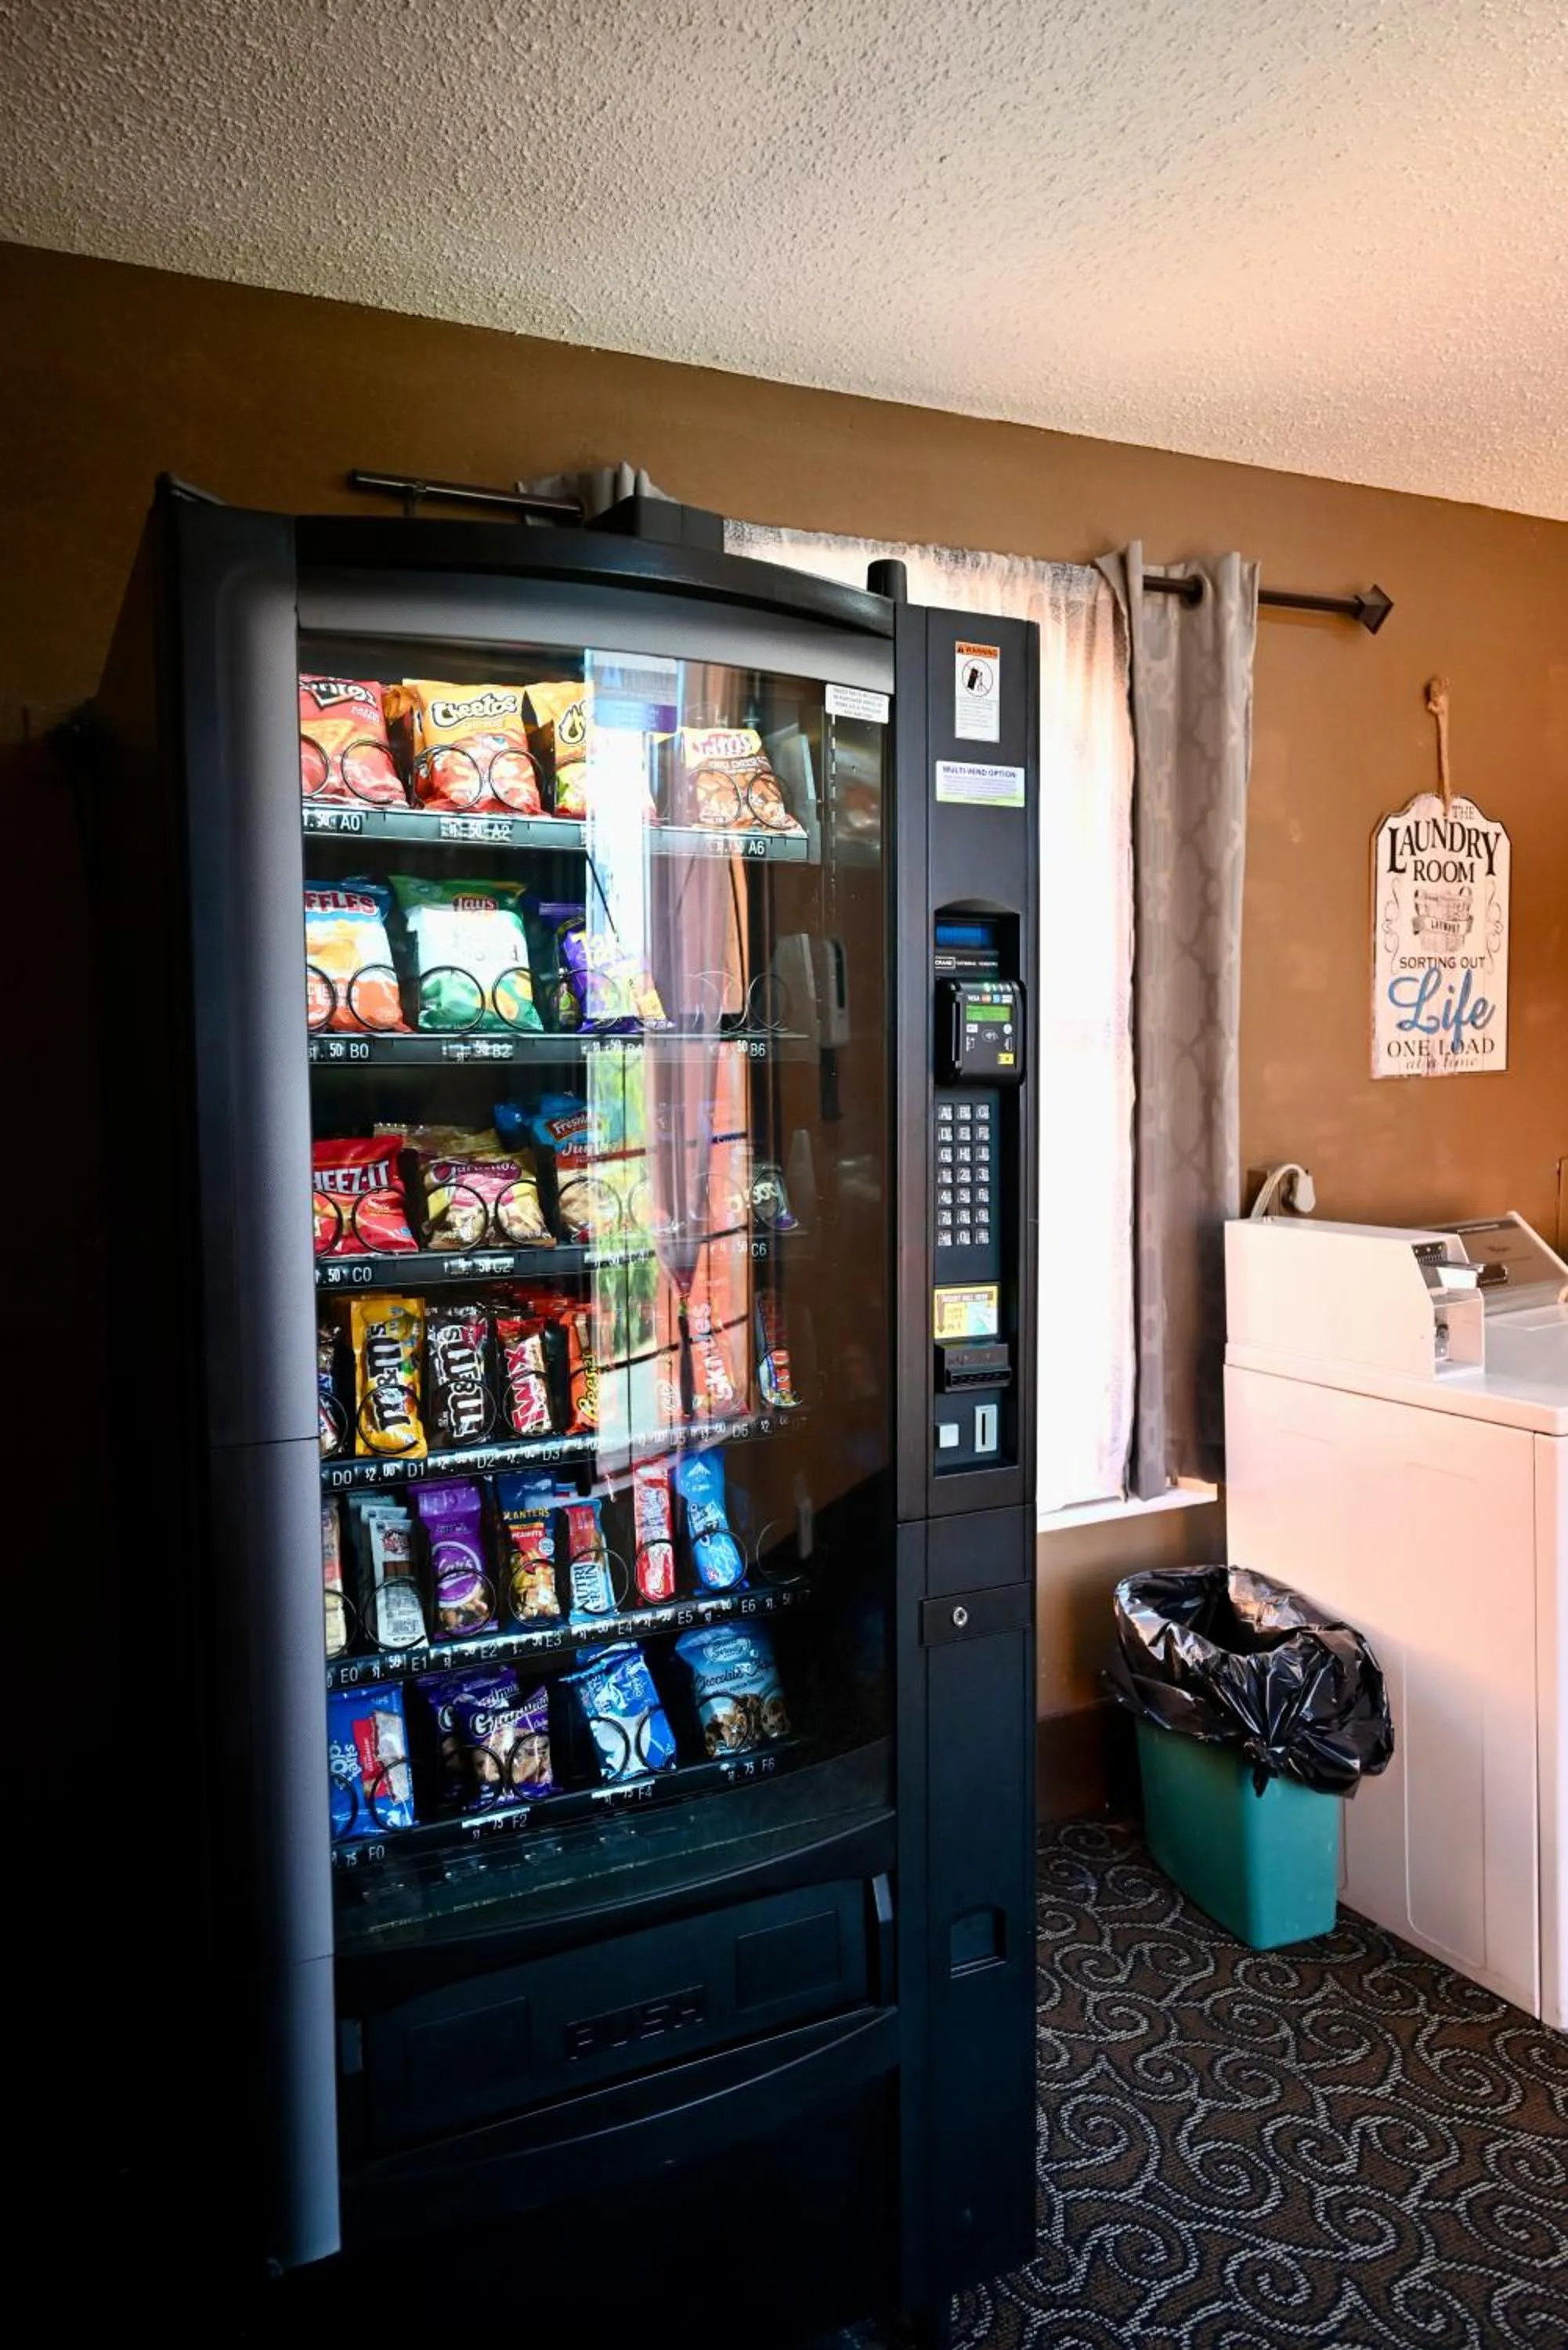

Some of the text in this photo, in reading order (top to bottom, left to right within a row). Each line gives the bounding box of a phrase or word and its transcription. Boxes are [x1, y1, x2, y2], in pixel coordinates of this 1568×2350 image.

[432, 692, 518, 728] Cheetos
[1452, 805, 1475, 819] THE
[340, 813, 360, 831] A0
[749, 841, 765, 855] A6
[1387, 818, 1501, 876] LAUNDRY
[1413, 859, 1475, 883] ROOM
[303, 891, 376, 914] FFLES
[1431, 920, 1461, 932] LAUNDRY
[1400, 956, 1485, 969] SORTING OUT
[1388, 966, 1496, 1055] Life
[350, 1043, 369, 1058] B0
[750, 1043, 766, 1058] B6
[1387, 1038, 1494, 1058] ONE LOAD
[313, 1160, 390, 1192] HEEZ-IT
[751, 1243, 767, 1256] C6
[352, 1267, 372, 1282] C0
[477, 1454, 496, 1470] D2
[543, 1447, 560, 1462] D3
[408, 1461, 425, 1478] D1
[333, 1470, 352, 1486] D0
[741, 1599, 757, 1614] E6
[677, 1611, 694, 1625] E5
[618, 1621, 633, 1636] E4
[546, 1633, 562, 1648] E3
[481, 1644, 497, 1660] E2
[412, 1656, 428, 1672] E1
[341, 1668, 359, 1683] E0
[762, 1757, 776, 1771] F6
[638, 1785, 652, 1800] F4
[512, 1814, 528, 1830] F2
[369, 1846, 385, 1862] F0
[567, 2000, 705, 2061] PUSH
